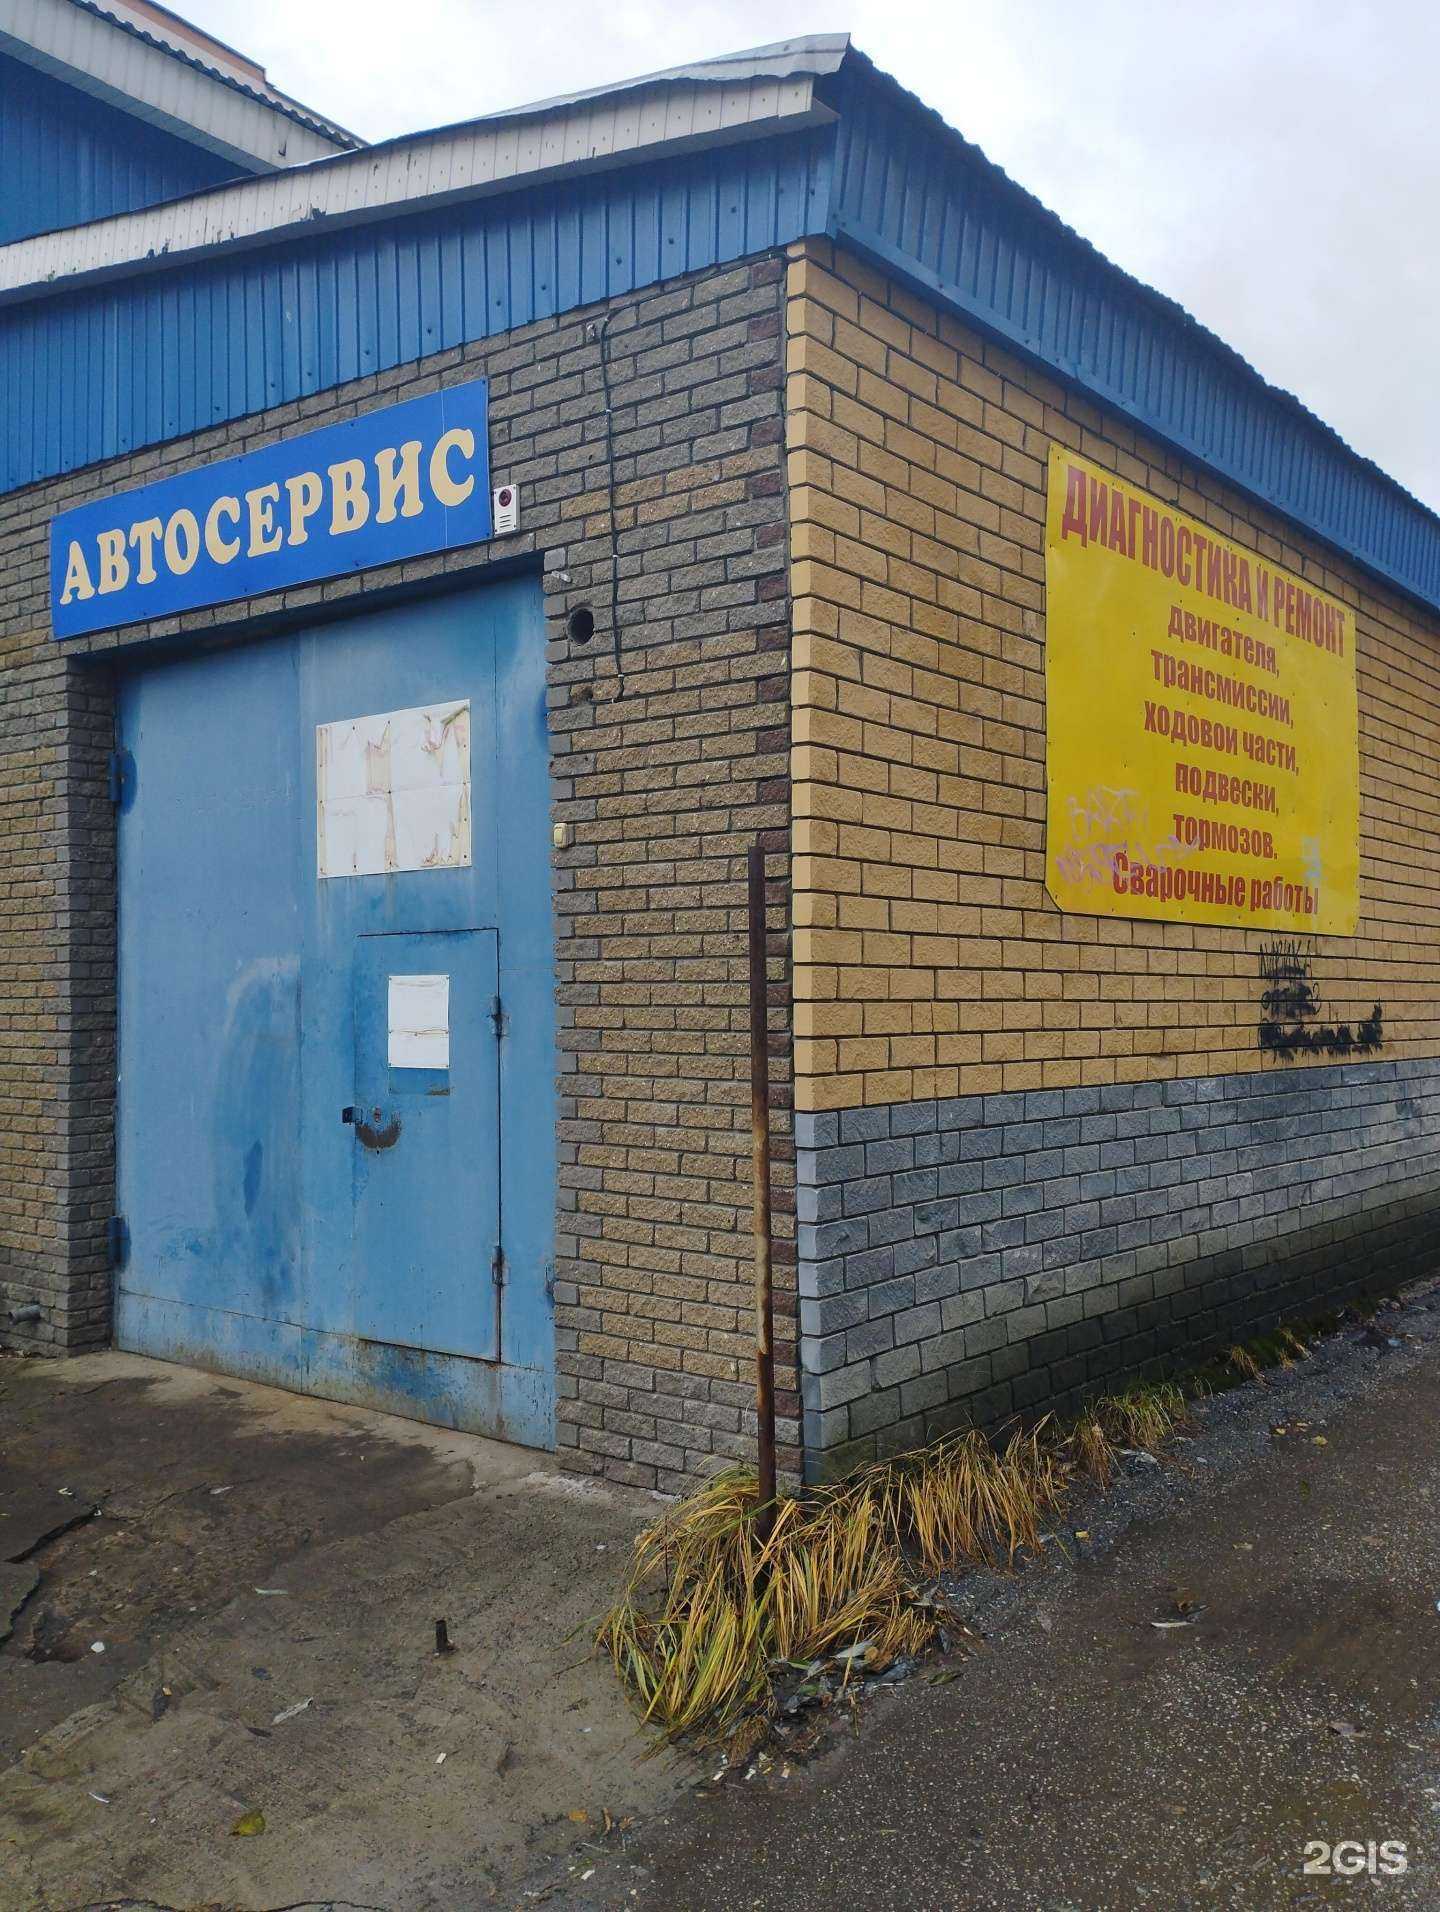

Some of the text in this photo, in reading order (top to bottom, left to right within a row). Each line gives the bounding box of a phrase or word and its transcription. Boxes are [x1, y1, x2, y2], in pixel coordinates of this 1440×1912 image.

[59, 428, 475, 605] АВТОСЕРВИС
[1061, 464, 1346, 657] ДИАГНОСТИКА И РЕМОНТ
[1168, 605, 1280, 678] двигателя,
[1151, 649, 1294, 729] трансмиссии,
[1242, 731, 1300, 776] части,
[1175, 762, 1280, 817] подвески,
[1173, 813, 1278, 860] тормозов.
[1113, 851, 1246, 908] Сварочные
[1250, 876, 1320, 915] работы
